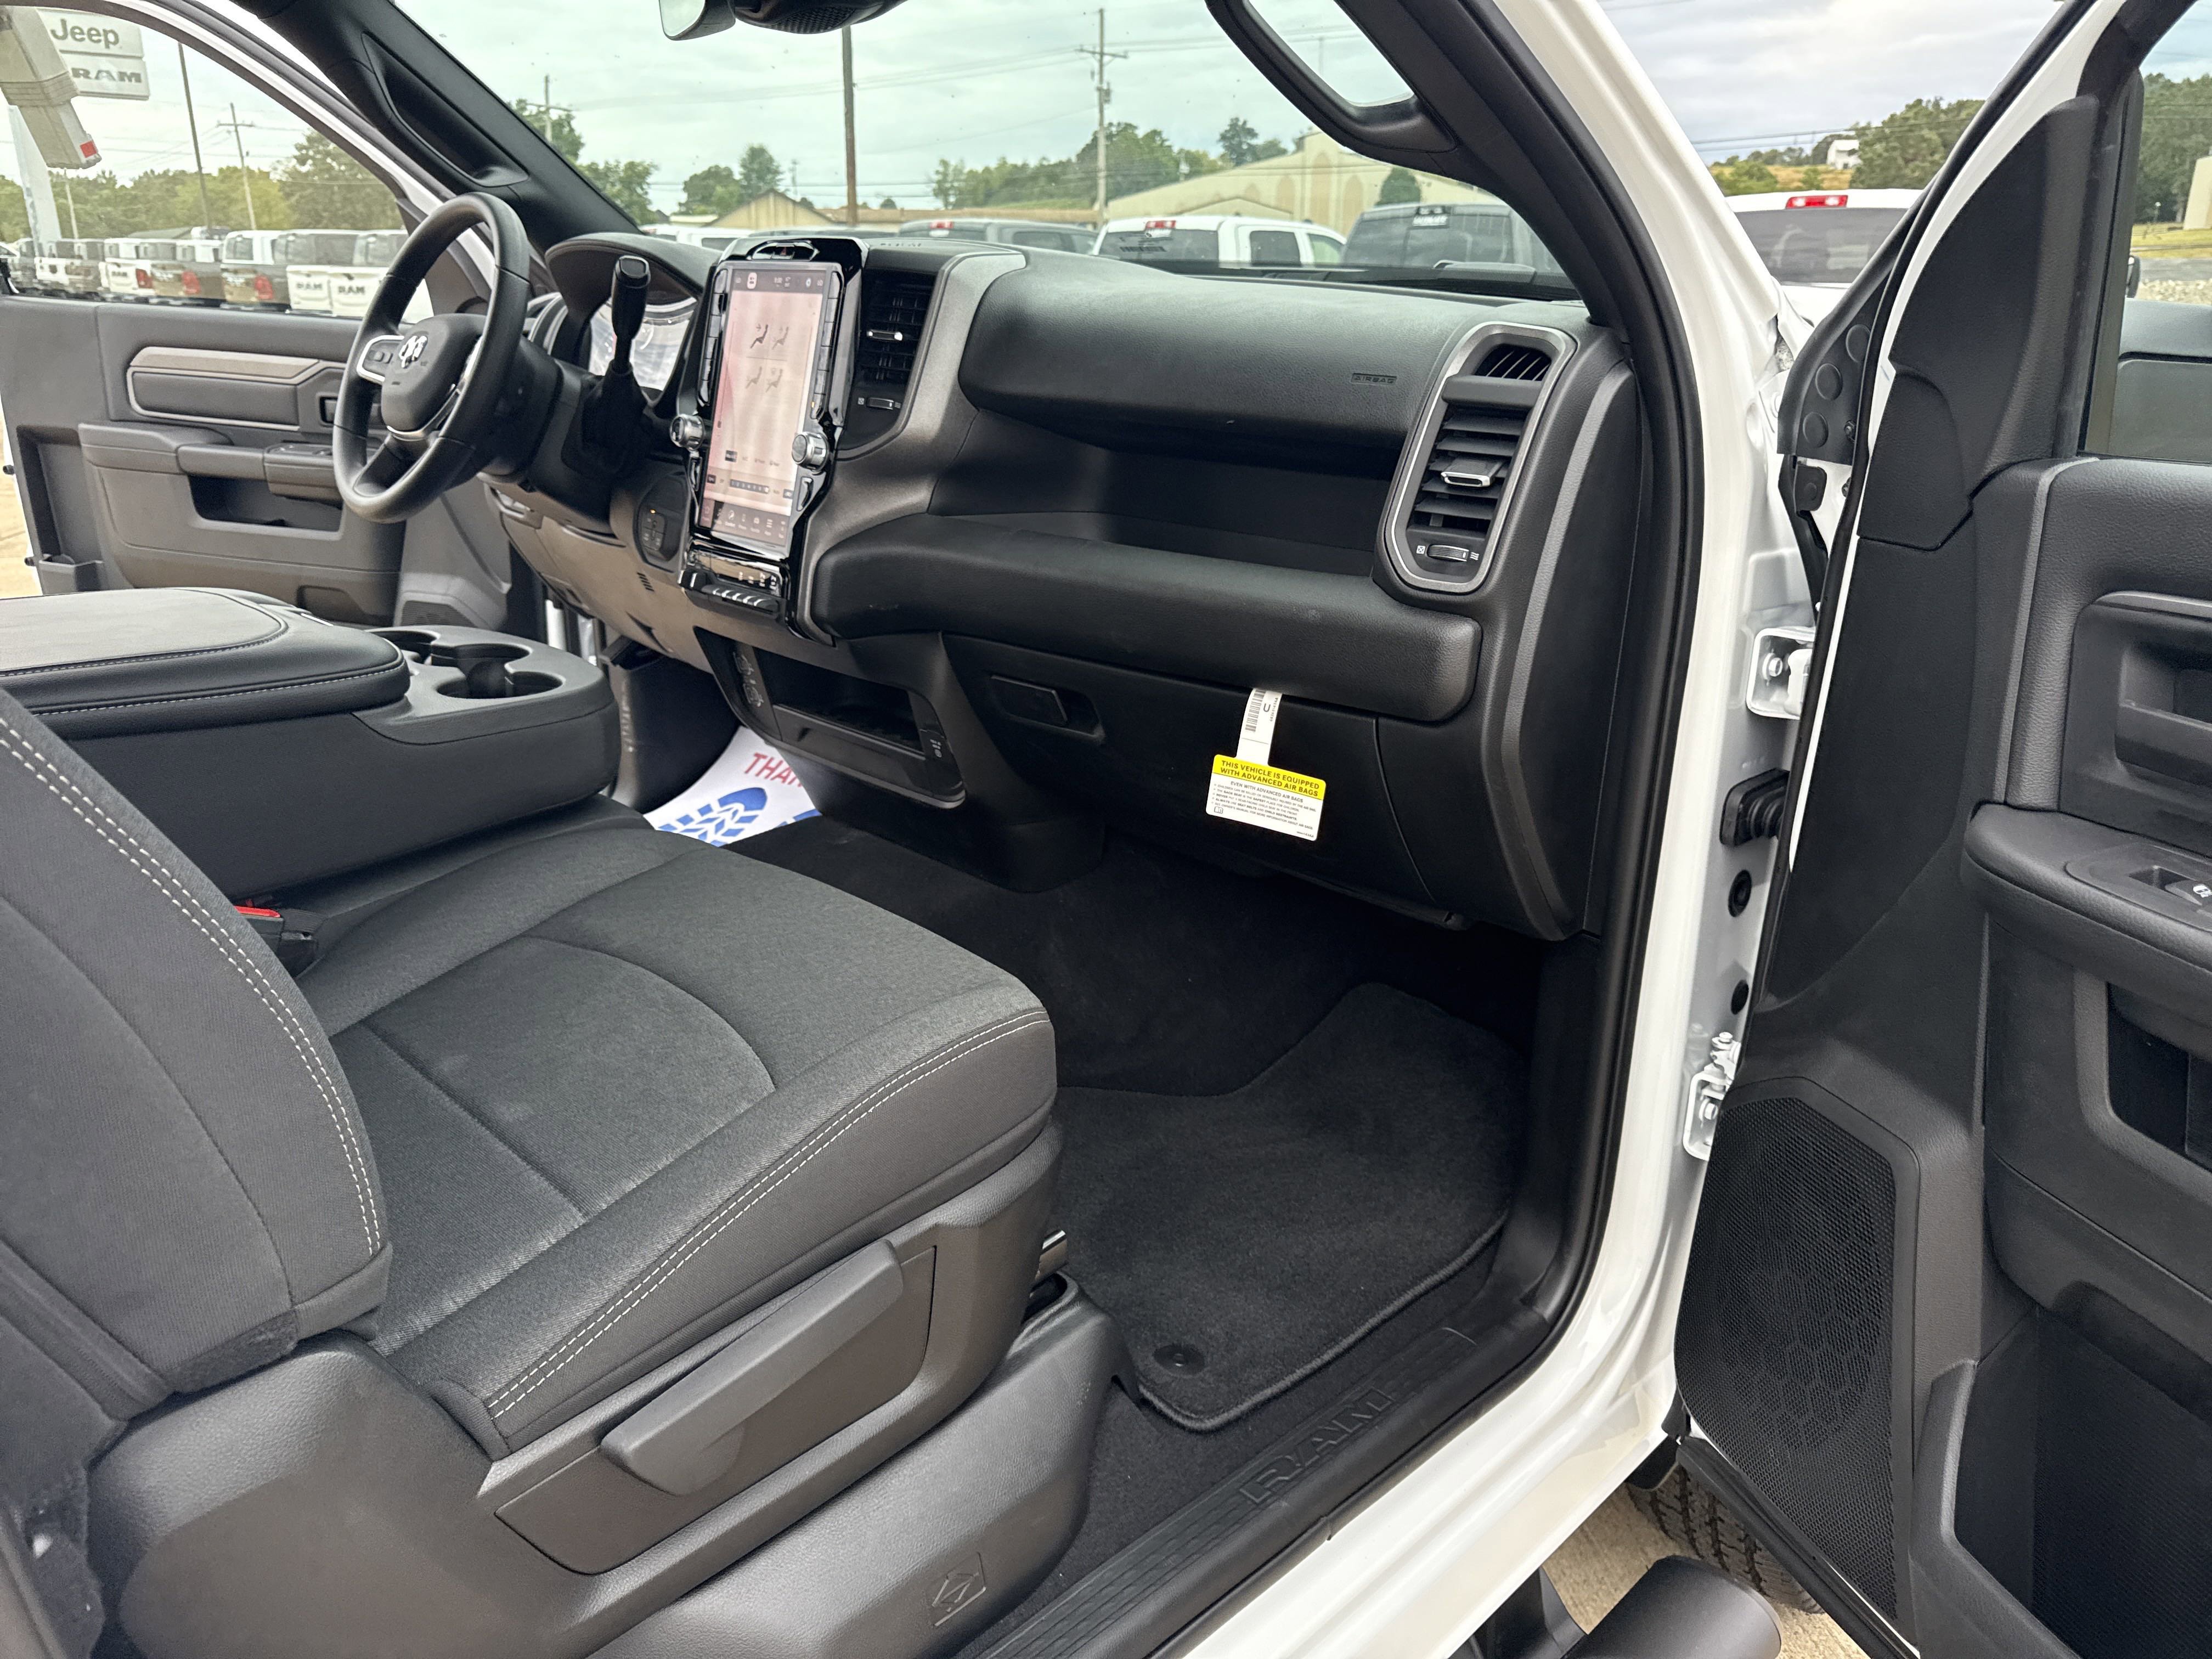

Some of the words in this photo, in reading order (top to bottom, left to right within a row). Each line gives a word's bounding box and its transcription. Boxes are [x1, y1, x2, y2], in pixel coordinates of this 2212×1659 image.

[50, 19, 119, 49] Jeep
[71, 67, 142, 83] RAM
[1353, 376, 1395, 384] AIRBAG
[1263, 703, 1271, 713] U
[1220, 768, 1239, 776] WITH
[1242, 772, 1283, 787] ADVANCED
[1299, 787, 1318, 797] BAGS
[1222, 760, 1238, 769] THIS
[1240, 765, 1272, 777] VEHICLE
[1282, 775, 1319, 789] EQUIPPED
[1257, 788, 1281, 797] ADVANCED
[1238, 1385, 1395, 1505] RAM
